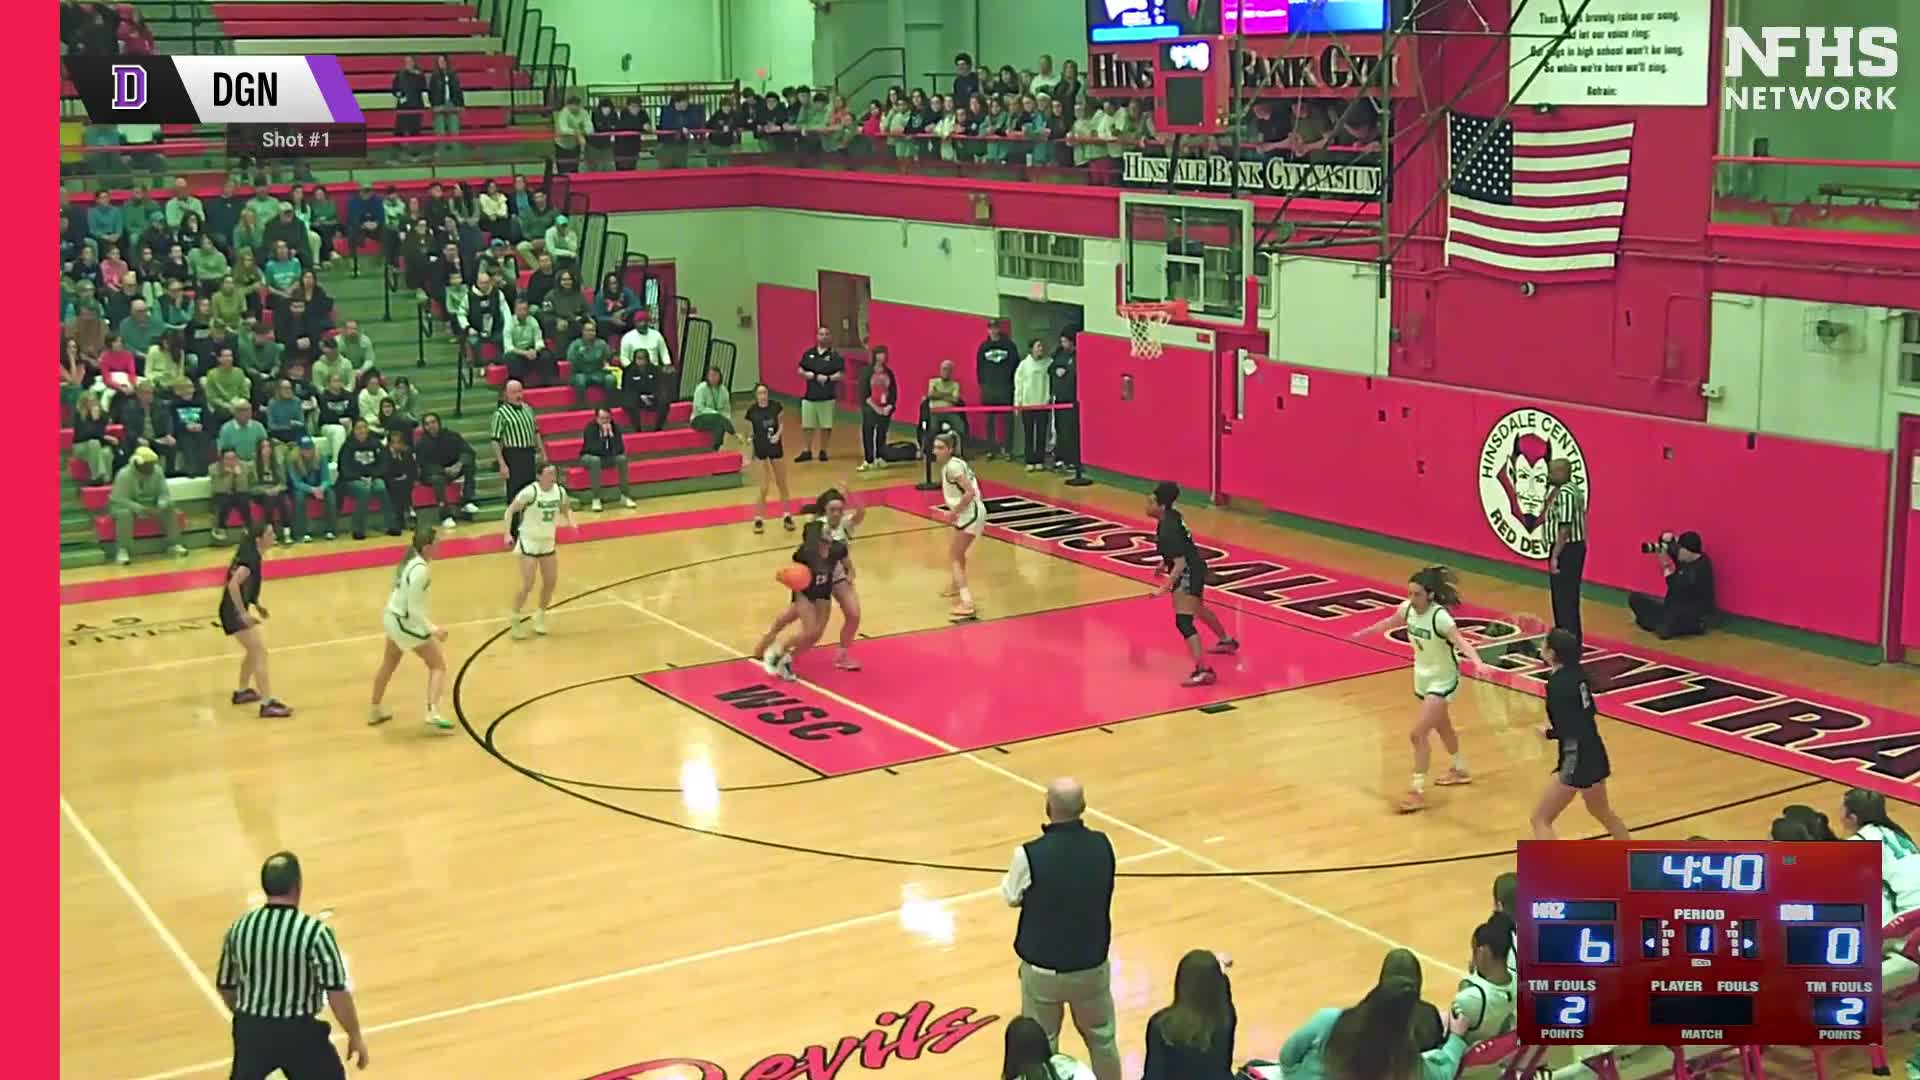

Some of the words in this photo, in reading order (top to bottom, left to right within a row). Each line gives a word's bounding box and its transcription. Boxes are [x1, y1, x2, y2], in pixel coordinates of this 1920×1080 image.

[1123, 152, 1206, 184] HINSALE
[1482, 412, 1536, 479] HINSDALE
[1490, 508, 1517, 545] RED
[1520, 536, 1550, 555] DEV
[714, 684, 862, 741] WSC
[1384, 616, 1920, 787] CENTRA
[582, 1001, 1000, 1080] evils
